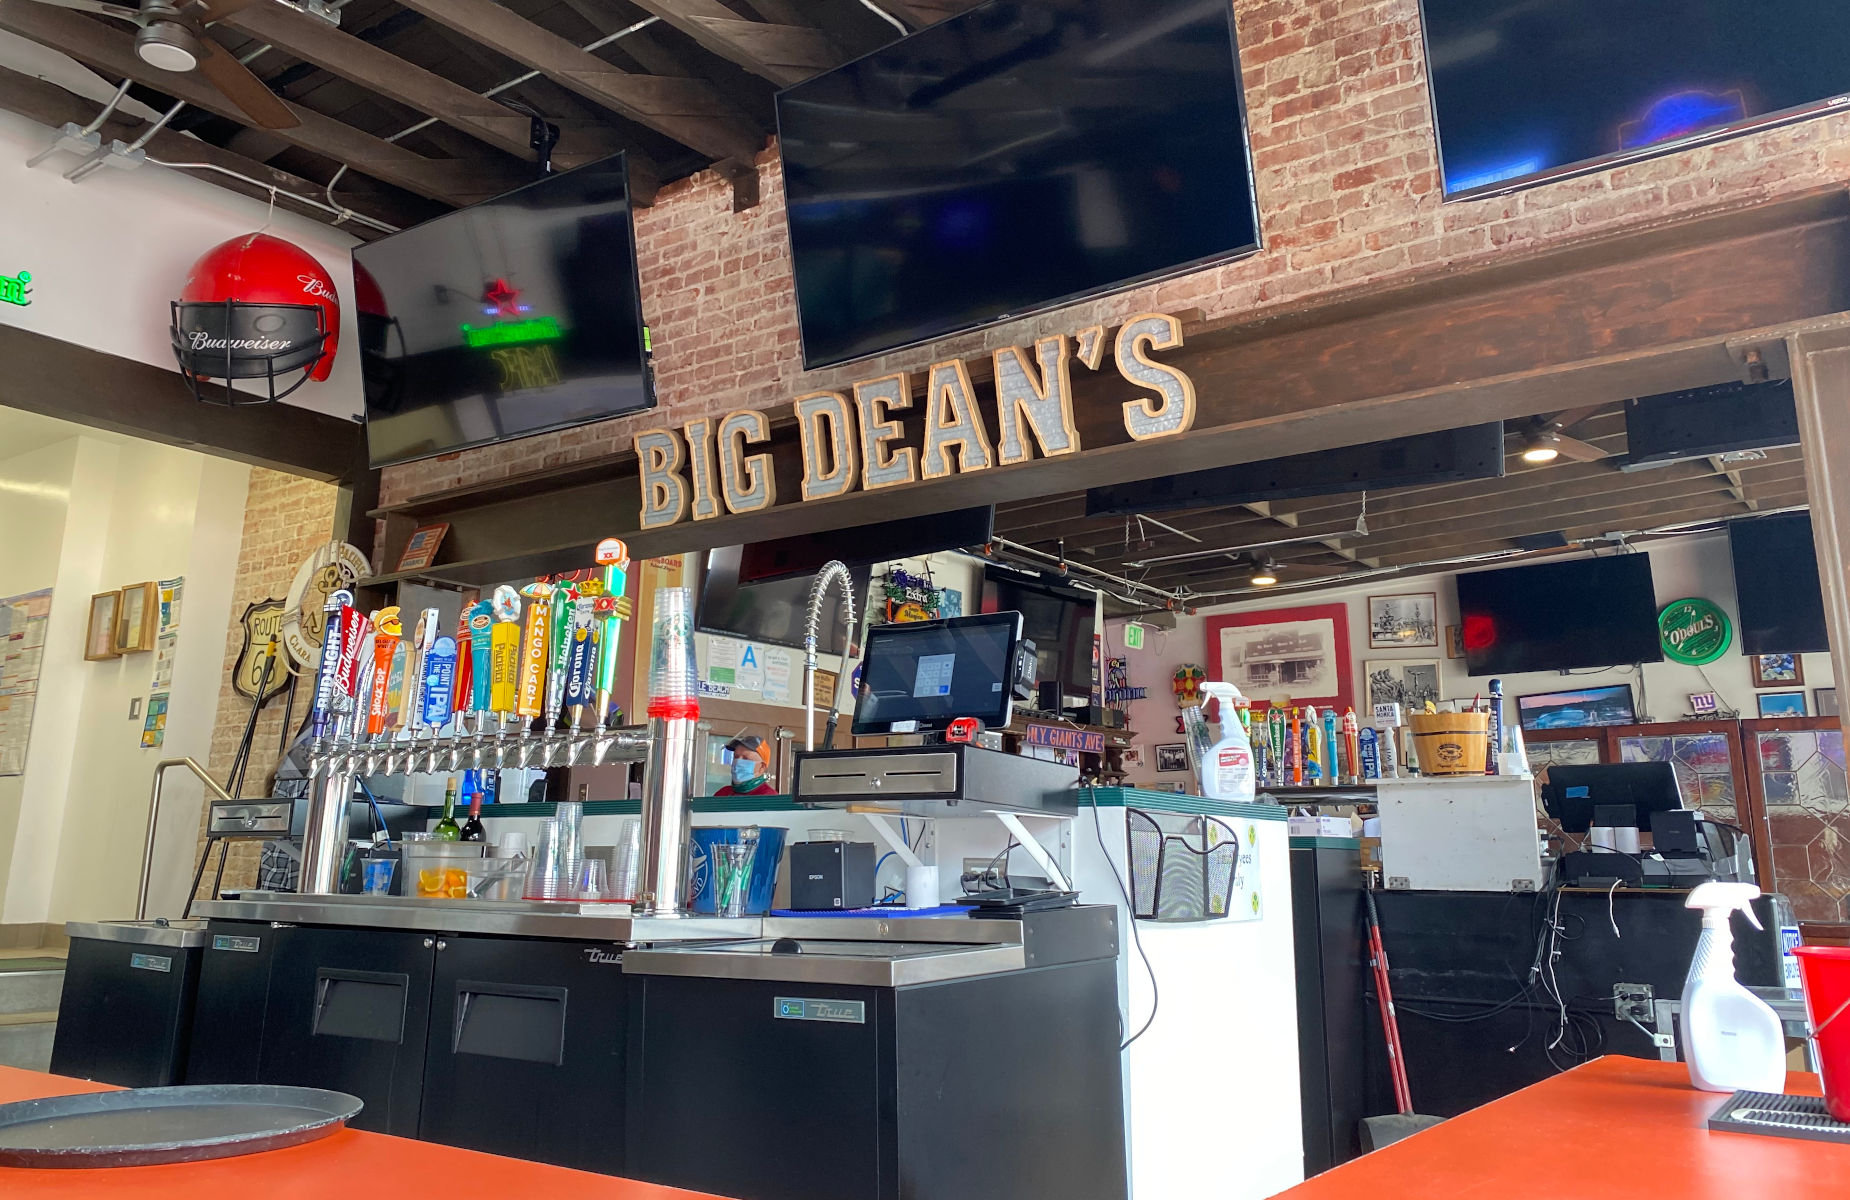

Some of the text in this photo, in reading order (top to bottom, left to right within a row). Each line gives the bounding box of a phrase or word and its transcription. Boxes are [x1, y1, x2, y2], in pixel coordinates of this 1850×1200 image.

[633, 312, 1197, 531] BIG DEAN'S
[593, 597, 617, 611] XX
[531, 605, 548, 659] MANGO
[1128, 626, 1143, 648] EXIT
[289, 634, 311, 662] CLARA
[332, 610, 360, 698] Budweiser
[740, 645, 758, 669] A
[316, 629, 342, 709] BUD LIGHT
[433, 663, 441, 674] THE
[441, 663, 452, 686] POINT
[568, 642, 585, 698] Corona
[584, 646, 598, 700] Corona
[371, 667, 386, 717] SHOCK TOP
[527, 663, 540, 707] CART
[428, 686, 449, 719] IPA
[1375, 704, 1394, 712] SANTA
[1376, 711, 1395, 719] MONICA
[1049, 729, 1083, 749] GIANTS
[1084, 733, 1102, 751] AVE
[1364, 758, 1376, 779] IPA
